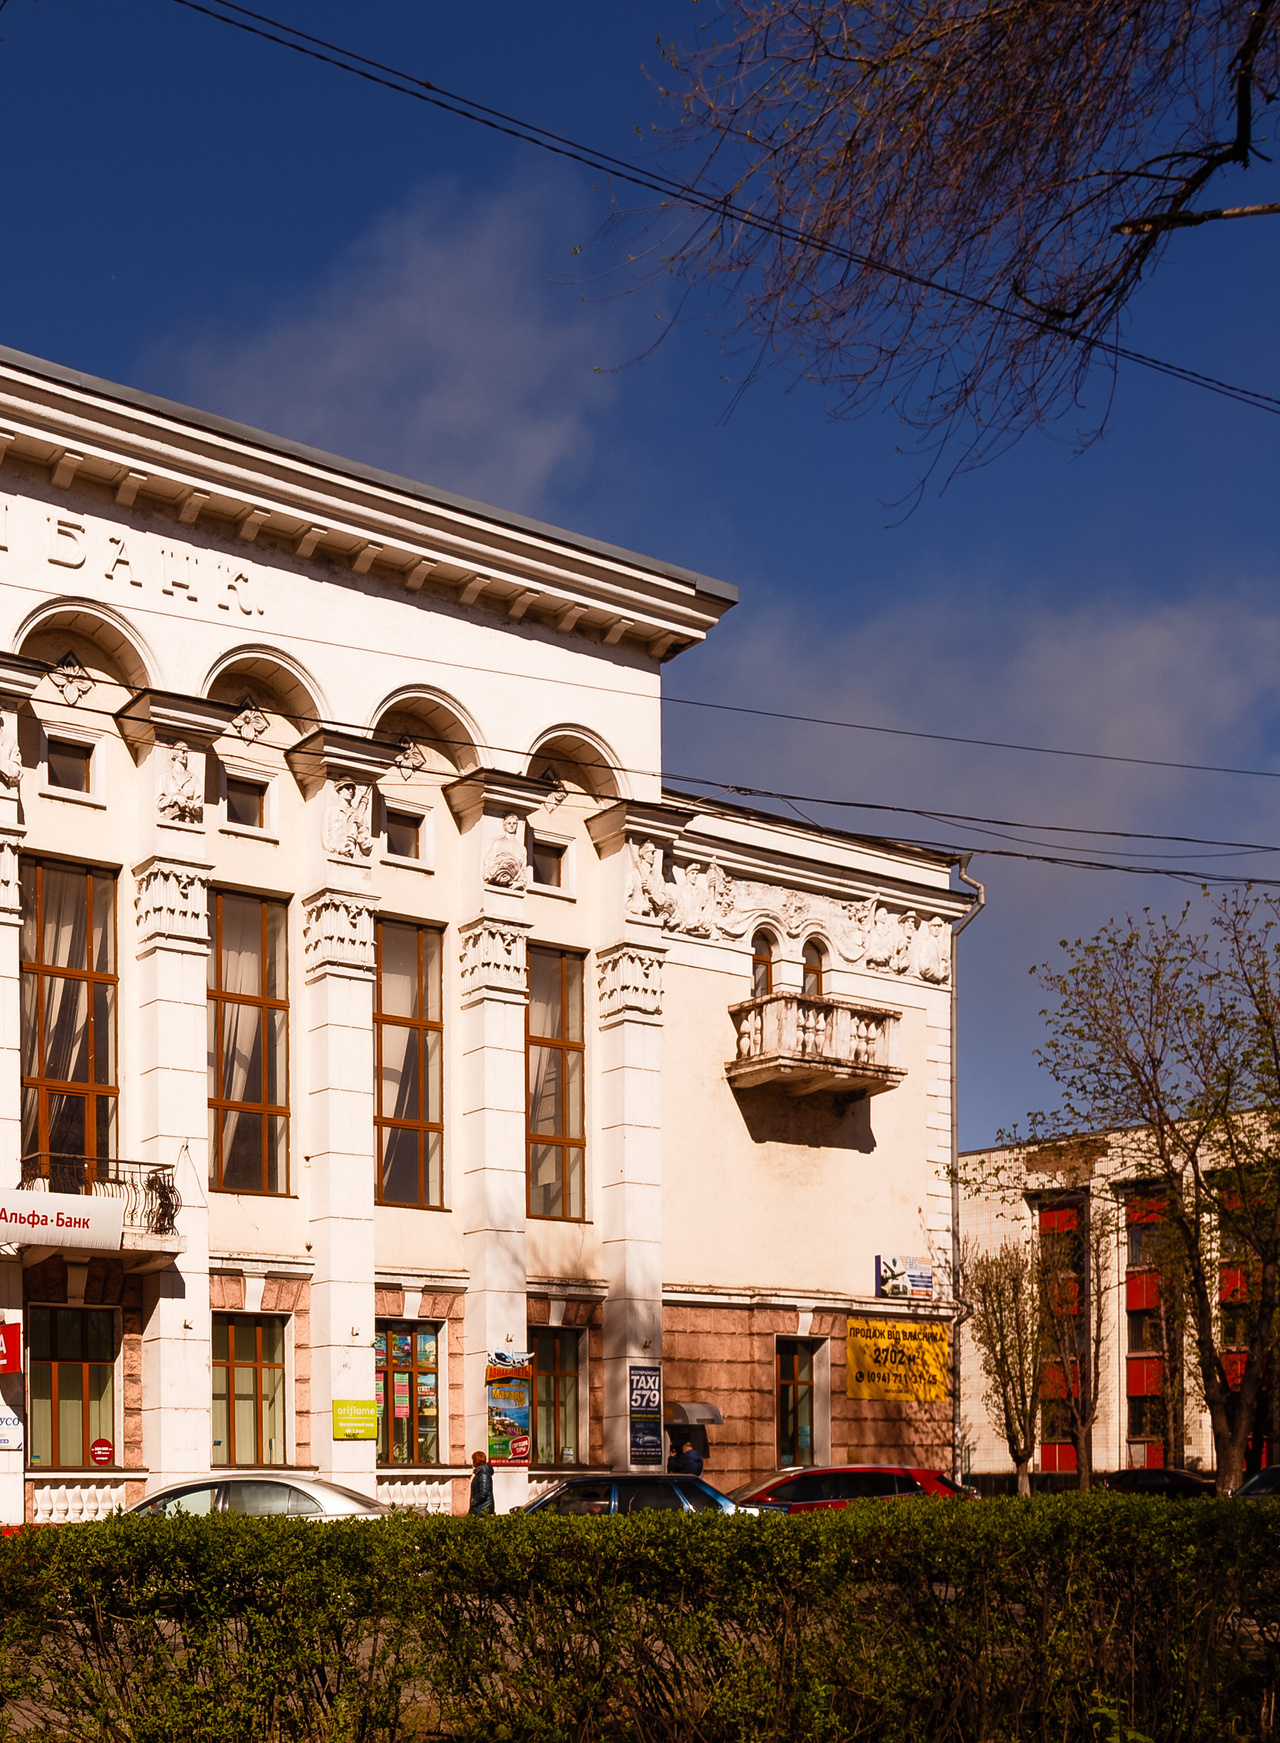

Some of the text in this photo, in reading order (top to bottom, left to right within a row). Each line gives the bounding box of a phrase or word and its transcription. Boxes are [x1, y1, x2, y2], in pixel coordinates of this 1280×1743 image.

[46, 515, 265, 616] БАНК
[849, 1327, 886, 1340] ПРОДАЖ
[873, 1347, 905, 1365] 2702
[489, 1366, 530, 1378] АВИАБИЛЕТЫ
[867, 1370, 890, 1384] (094)
[631, 1375, 659, 1390] TAXI
[492, 1388, 526, 1400] Махаон
[631, 1390, 659, 1407] 579
[337, 1406, 376, 1416] oriflame
